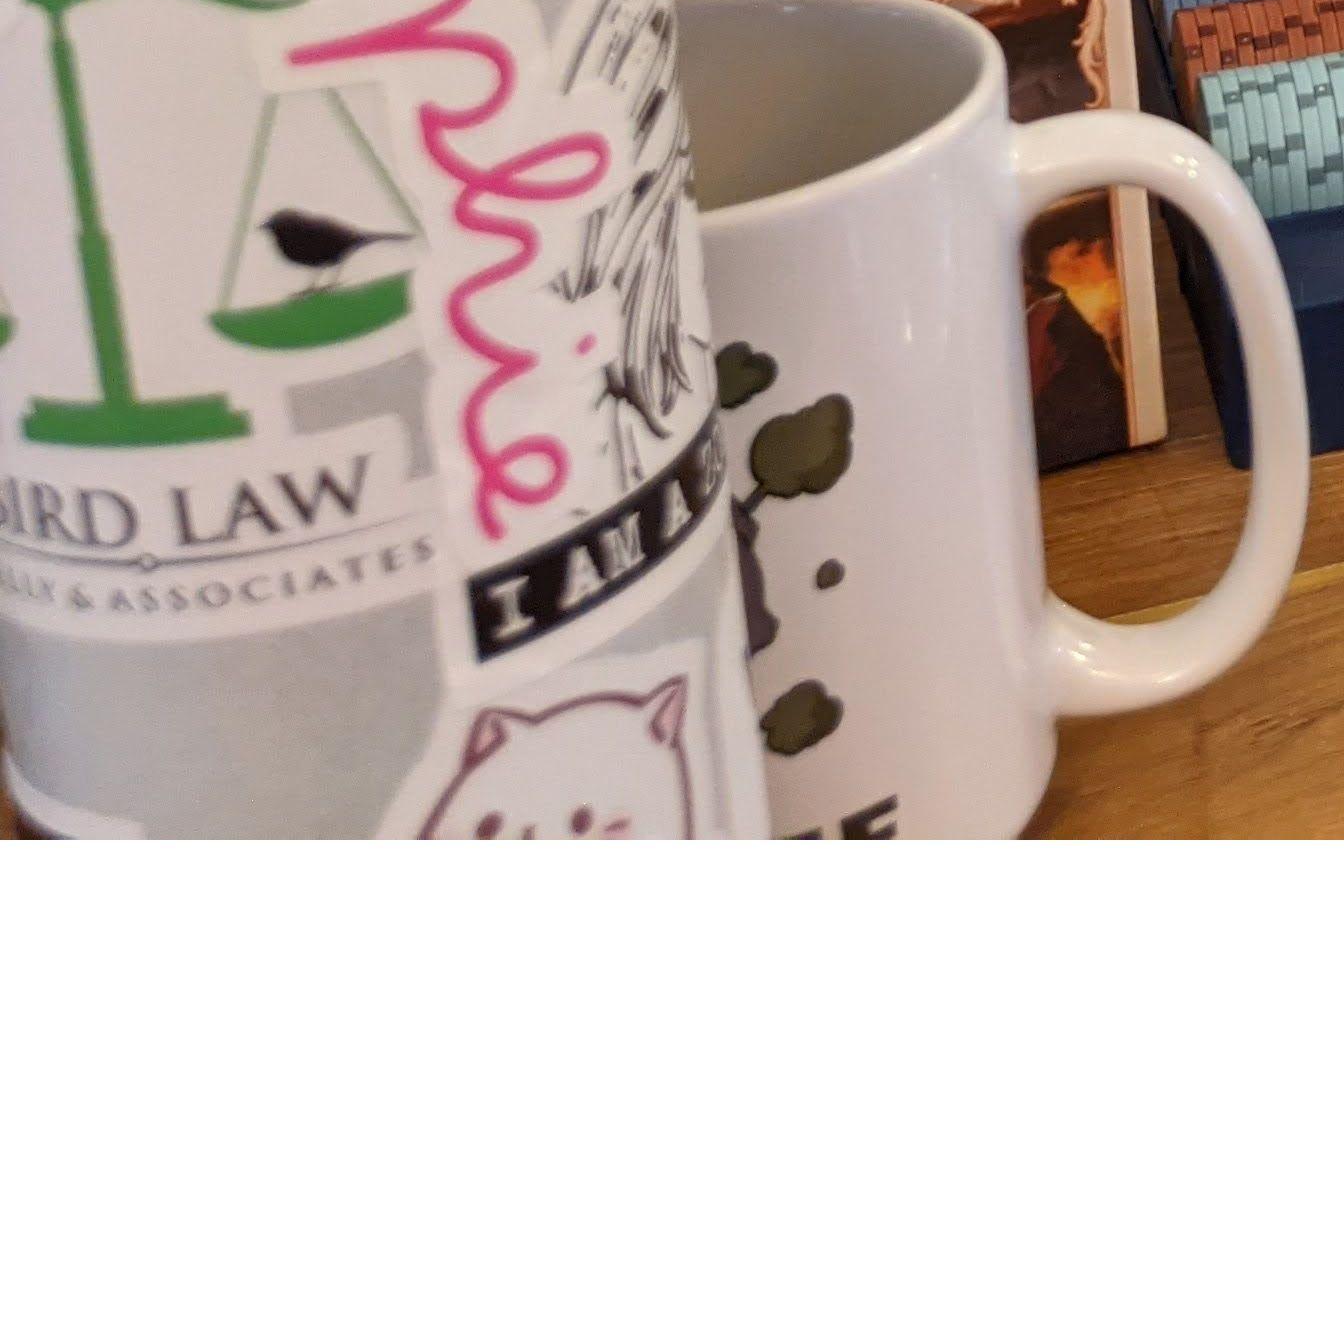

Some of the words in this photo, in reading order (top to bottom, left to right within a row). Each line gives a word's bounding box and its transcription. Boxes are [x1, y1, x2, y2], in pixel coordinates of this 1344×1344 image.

[168, 453, 370, 546] LAW
[108, 534, 436, 612] ASSOCIATES
[490, 575, 535, 641] I
[559, 511, 647, 611] AM
[660, 478, 694, 540] A
